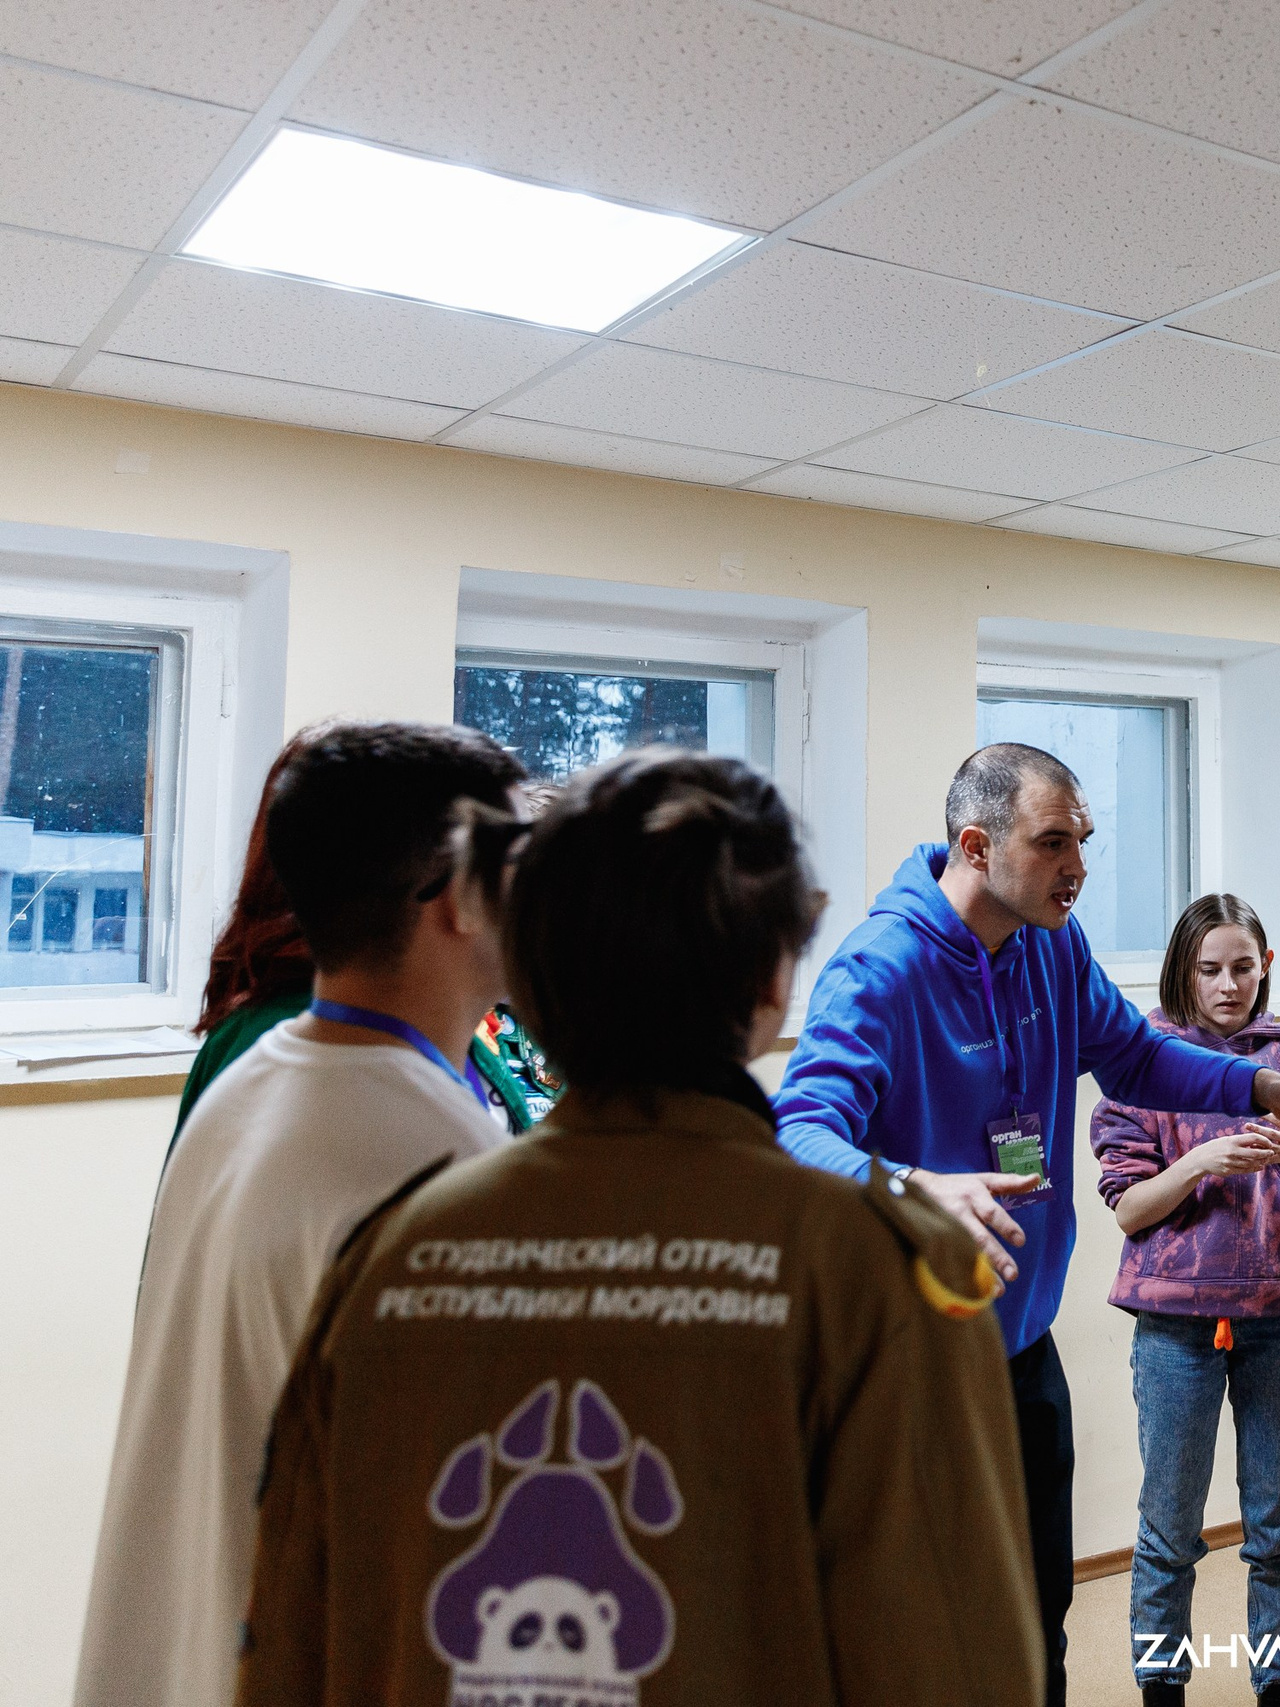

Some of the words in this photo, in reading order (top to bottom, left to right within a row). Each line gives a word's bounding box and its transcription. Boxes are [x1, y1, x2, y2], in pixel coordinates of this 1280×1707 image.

[406, 1235, 659, 1273] СТУДЕНЧЕСКИЙ
[659, 1237, 783, 1283] ОТРЯД
[373, 1285, 587, 1321] РЕСПУБЛИКИ
